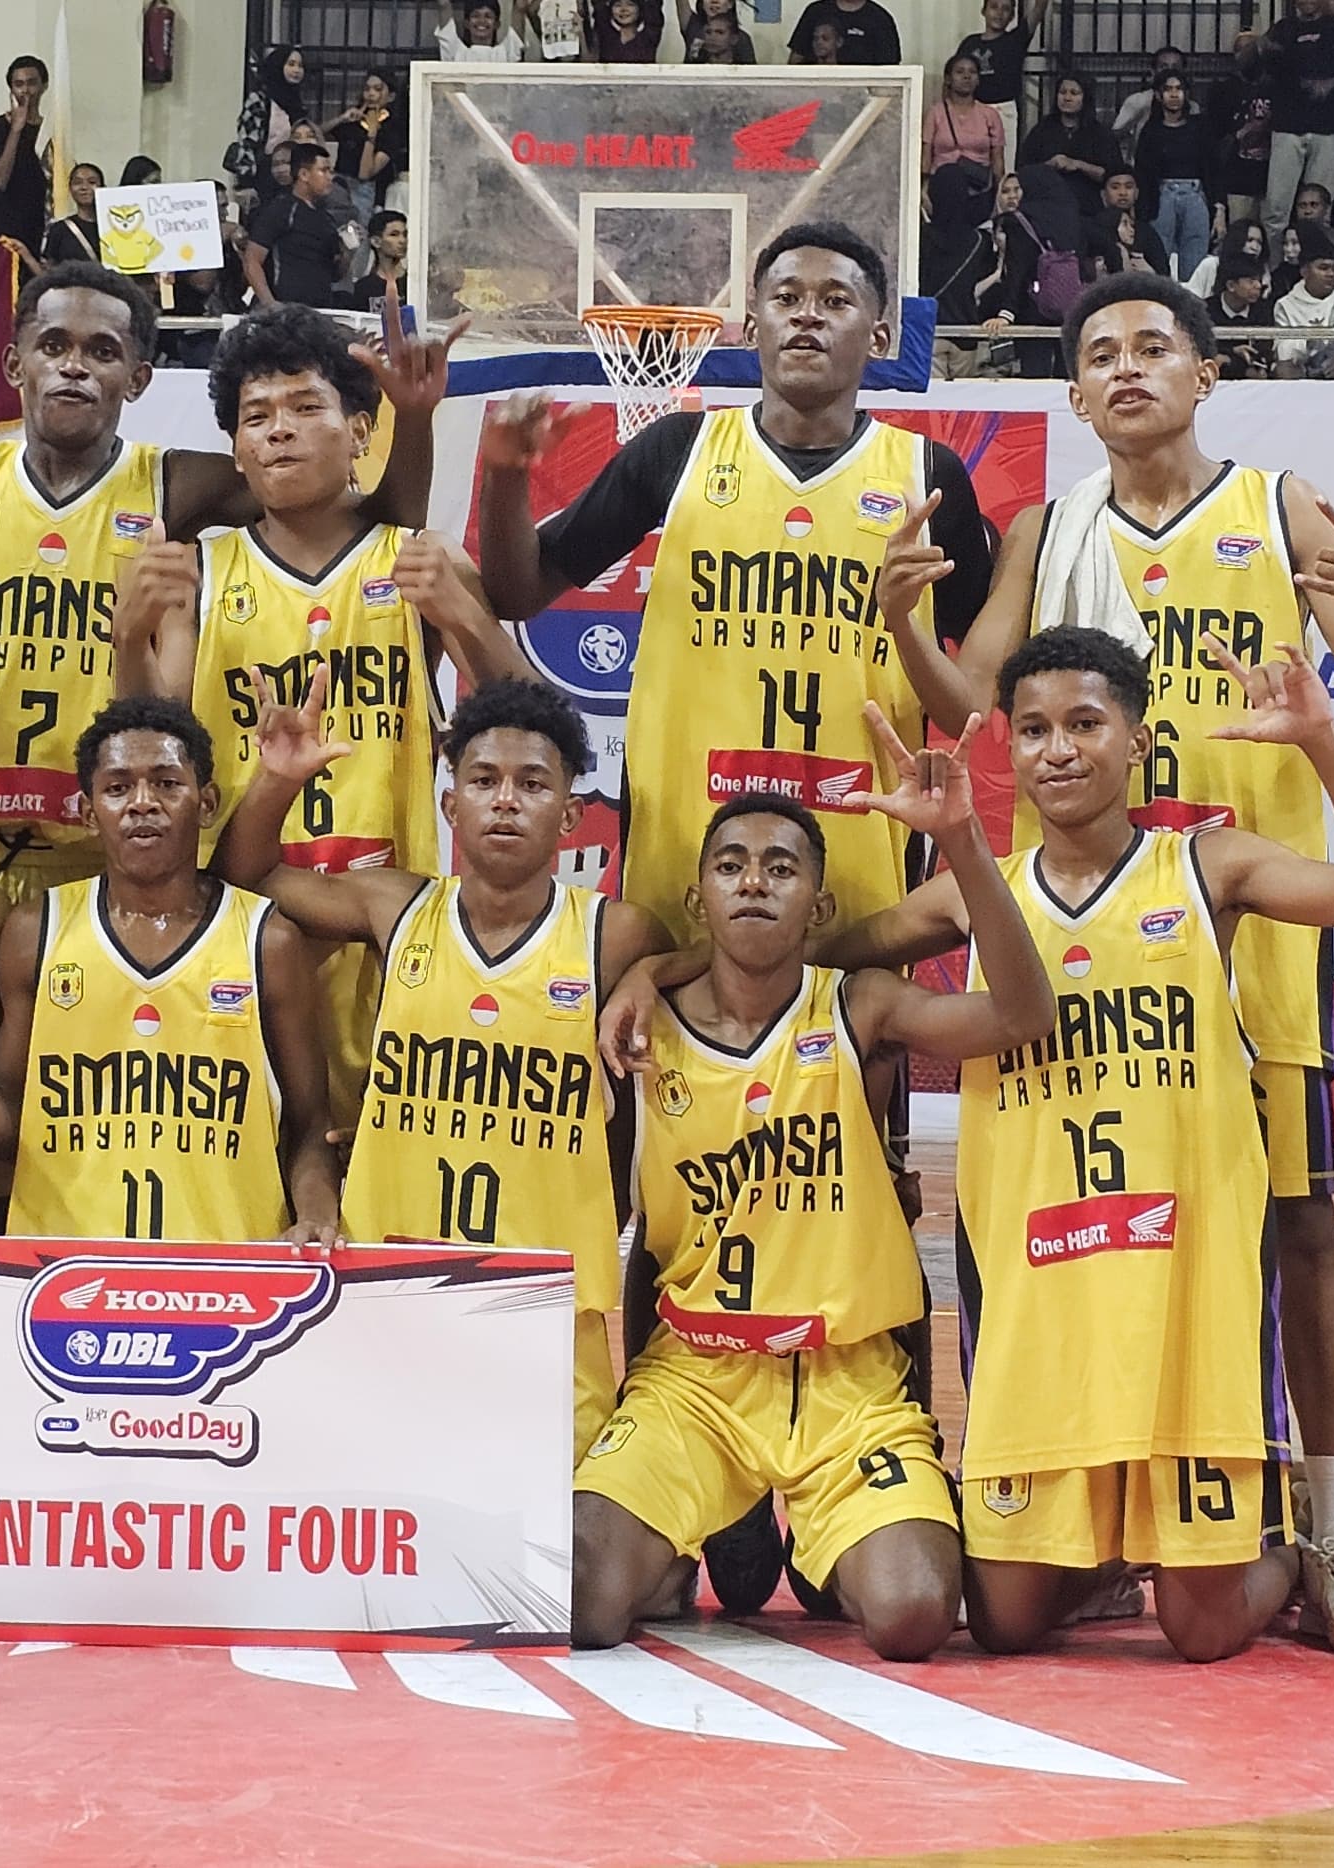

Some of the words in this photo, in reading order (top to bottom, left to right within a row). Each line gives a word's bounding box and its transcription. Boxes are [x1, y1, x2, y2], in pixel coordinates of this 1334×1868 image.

[512, 131, 577, 166] One
[583, 134, 696, 169] HEART.
[691, 618, 889, 667] JAYAPURA
[15, 690, 59, 765] 7
[759, 667, 821, 751] 14
[710, 772, 742, 793] One
[745, 772, 805, 799] HEART.
[997, 985, 1194, 1075] ANSA
[39, 1050, 250, 1125] SMANSA
[373, 1030, 592, 1120] SMANSA
[997, 1057, 1195, 1111] JAYAPURA
[42, 1121, 241, 1160] JAYAPURA
[372, 1100, 583, 1155] JAYAPURA
[1063, 1111, 1127, 1197] 15
[122, 1169, 163, 1241] 11
[438, 1157, 500, 1244] 10
[715, 1233, 755, 1312] 9
[1030, 1237, 1065, 1258] One
[104, 1290, 257, 1314] HONDA
[99, 1332, 177, 1367] DBL
[109, 1410, 184, 1439] Good
[188, 1411, 244, 1448] Day
[858, 1446, 907, 1489] 9
[1177, 1457, 1235, 1522] 15
[267, 1505, 419, 1577] FOUR
